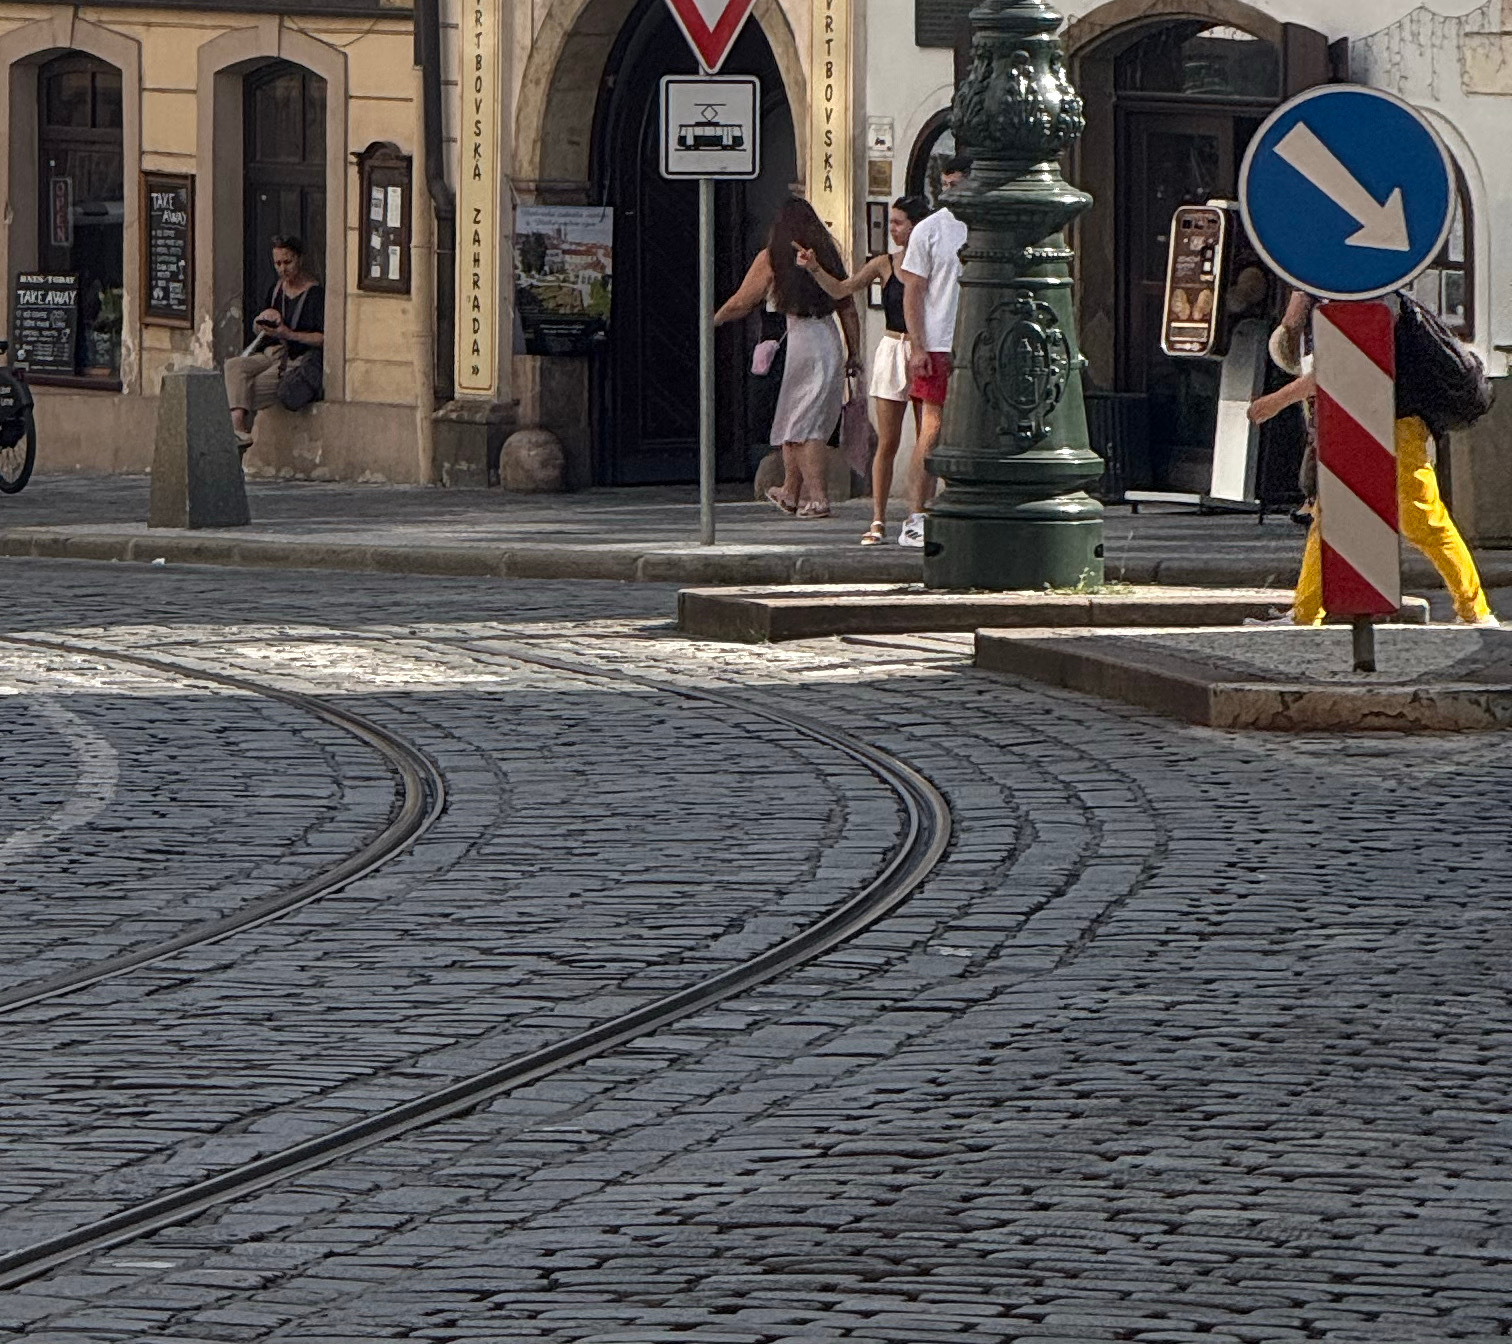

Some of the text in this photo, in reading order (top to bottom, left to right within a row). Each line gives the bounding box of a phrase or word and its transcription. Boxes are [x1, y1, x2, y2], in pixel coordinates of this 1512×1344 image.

[151, 193, 175, 210] TAKE
[17, 290, 77, 305] TAKE AWAY
